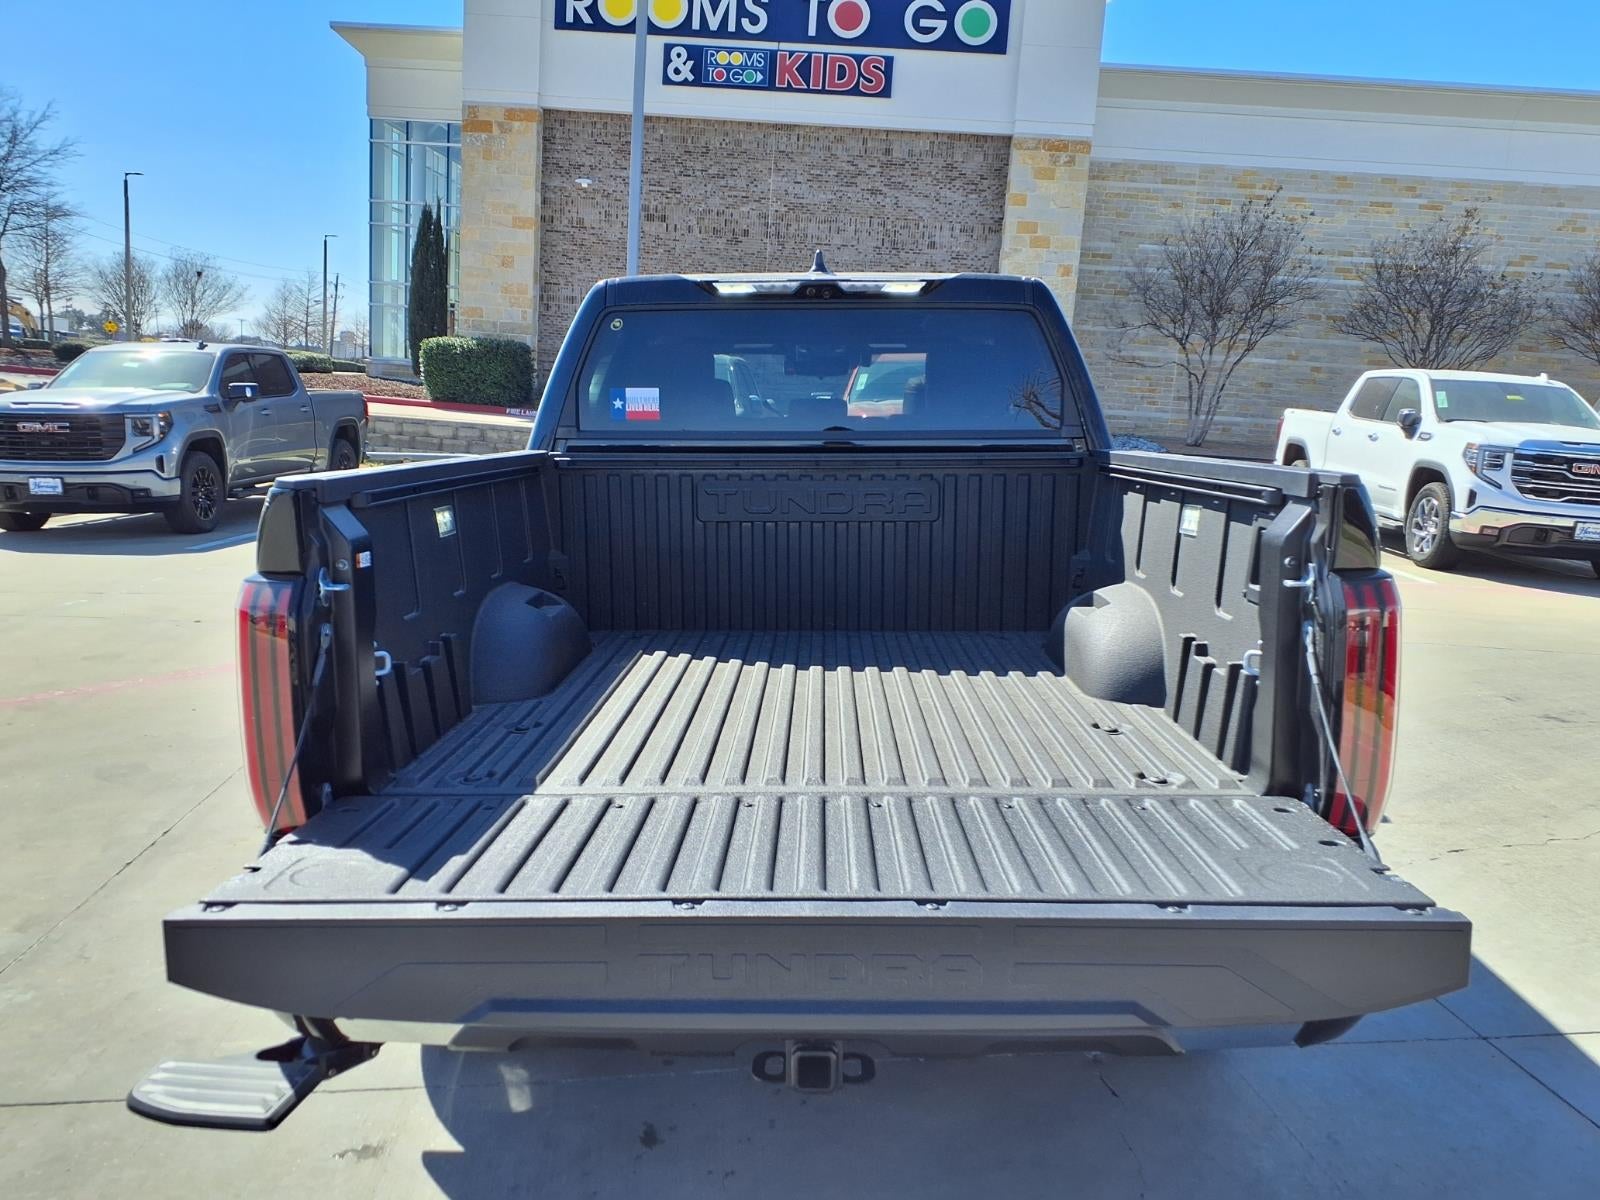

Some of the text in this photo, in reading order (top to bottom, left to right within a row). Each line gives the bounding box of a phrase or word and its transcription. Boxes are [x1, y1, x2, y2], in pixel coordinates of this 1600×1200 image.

[565, 0, 998, 46] ROOMS TO GO
[667, 46, 695, 82] &
[707, 50, 765, 67] ROOMS
[775, 51, 885, 94] KIDS
[707, 68, 757, 84] TO GO
[16, 422, 70, 433] GMC
[703, 489, 932, 515] TUNDRA
[637, 953, 983, 990] TUNDRA
